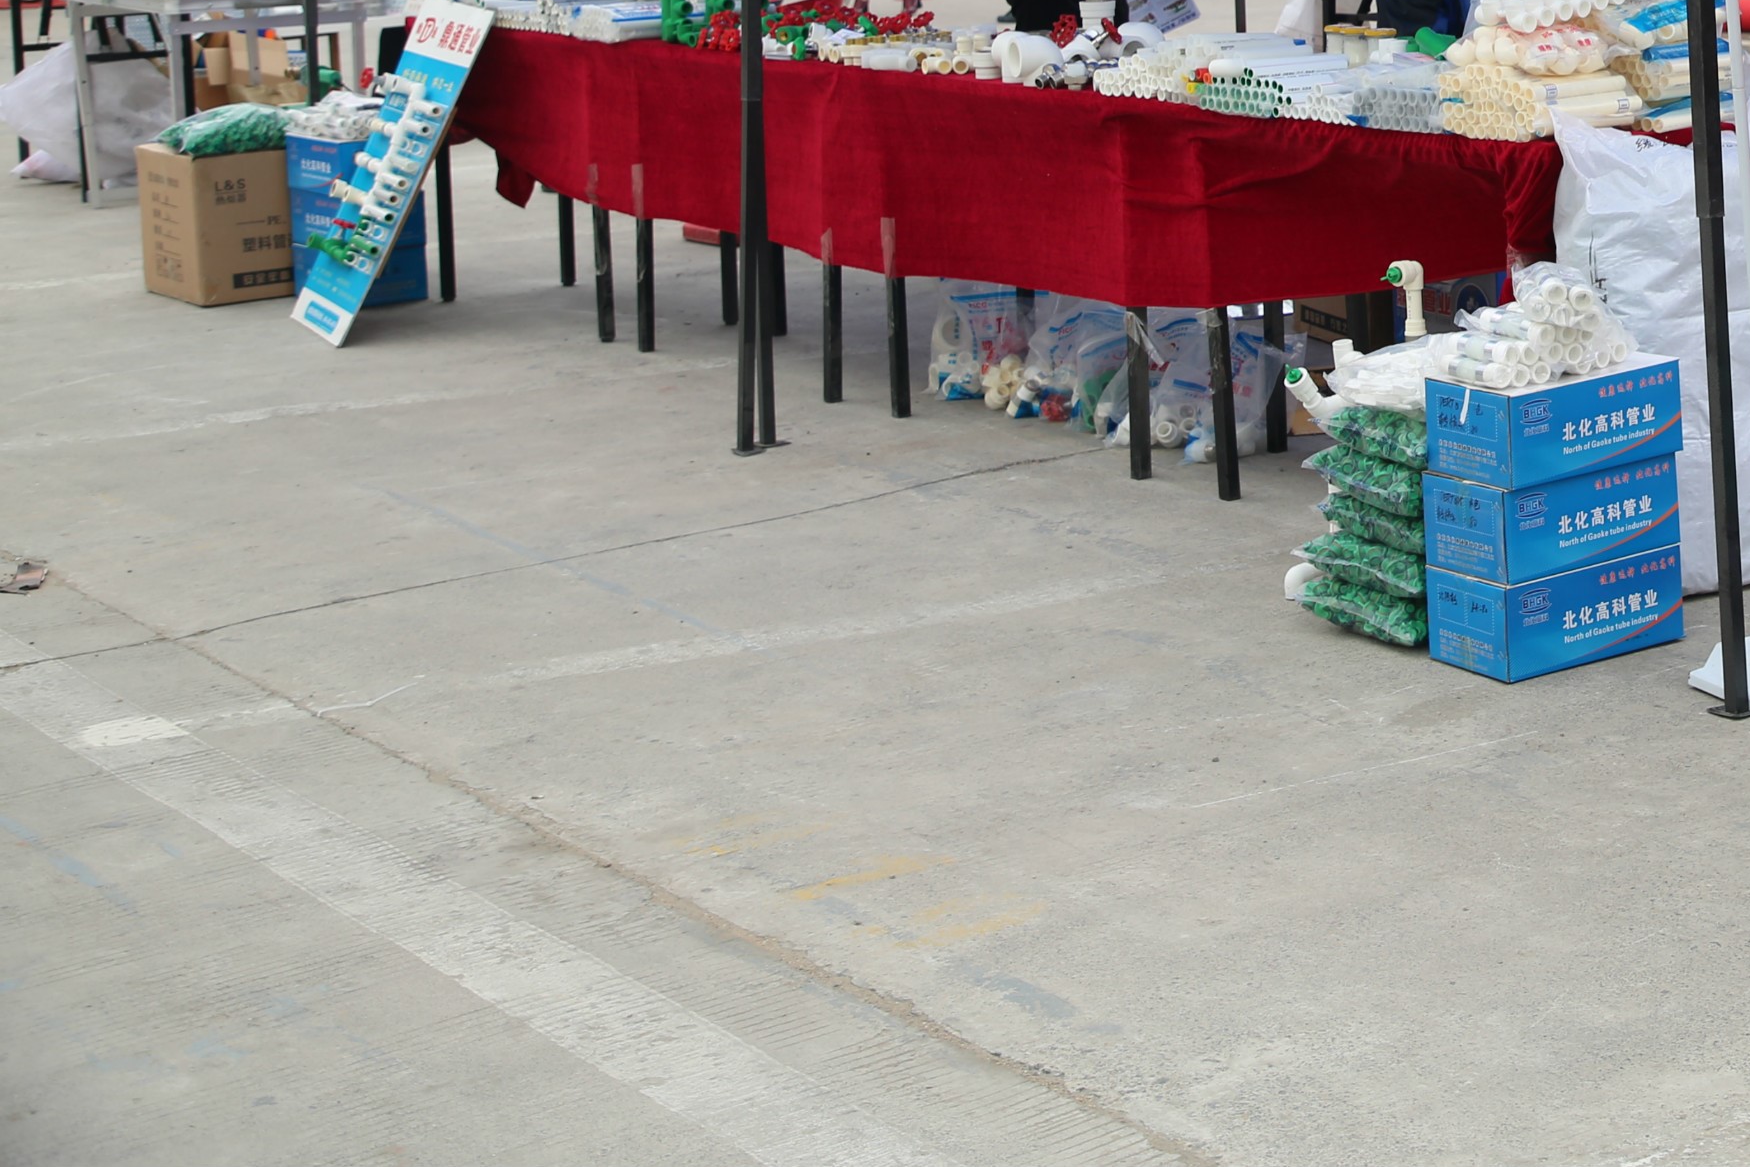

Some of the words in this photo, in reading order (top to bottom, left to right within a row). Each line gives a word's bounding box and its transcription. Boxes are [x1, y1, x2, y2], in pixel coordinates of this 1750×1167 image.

[1522, 404, 1549, 419] BHGK
[1562, 403, 1656, 442] 北化高科管业
[1563, 444, 1582, 456] North
[1583, 442, 1590, 452] of
[1591, 437, 1612, 449] Gaoke
[1612, 433, 1627, 445] tube
[1628, 428, 1655, 442] industry
[1518, 497, 1545, 513] BHGK
[1558, 494, 1653, 535] 北化高科管业
[1559, 537, 1579, 549] North
[1580, 535, 1587, 545] of
[1587, 530, 1609, 543] Gaoke
[1609, 526, 1624, 537] tube
[1625, 519, 1652, 534] industry
[1522, 595, 1549, 610] BHGK
[1562, 588, 1659, 631] 北化高科管业
[1564, 632, 1583, 645] North
[1585, 630, 1592, 640] of
[1593, 625, 1614, 639] Gaoke
[1615, 621, 1630, 632] tube
[1631, 614, 1659, 629] industry
